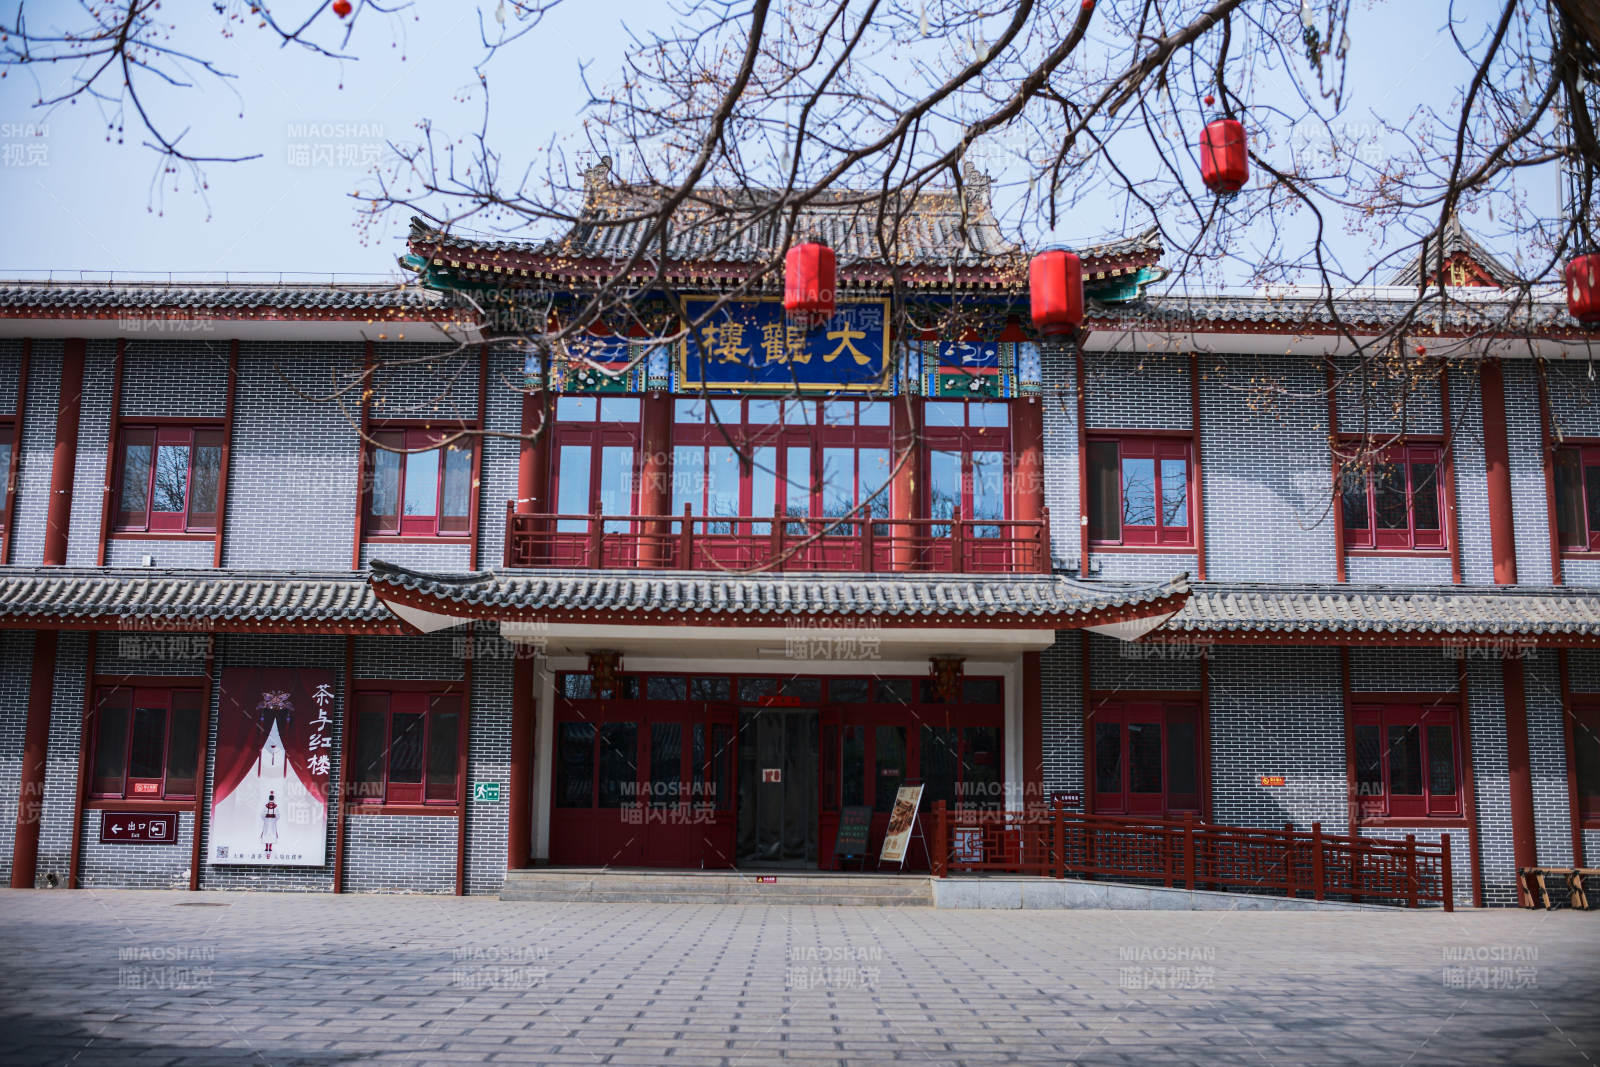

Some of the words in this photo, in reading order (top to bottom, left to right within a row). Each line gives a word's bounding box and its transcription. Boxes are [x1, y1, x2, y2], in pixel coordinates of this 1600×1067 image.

[701, 321, 872, 365] 大觀樓
[307, 683, 335, 775] 茶与红楼
[127, 821, 146, 831] 出口
